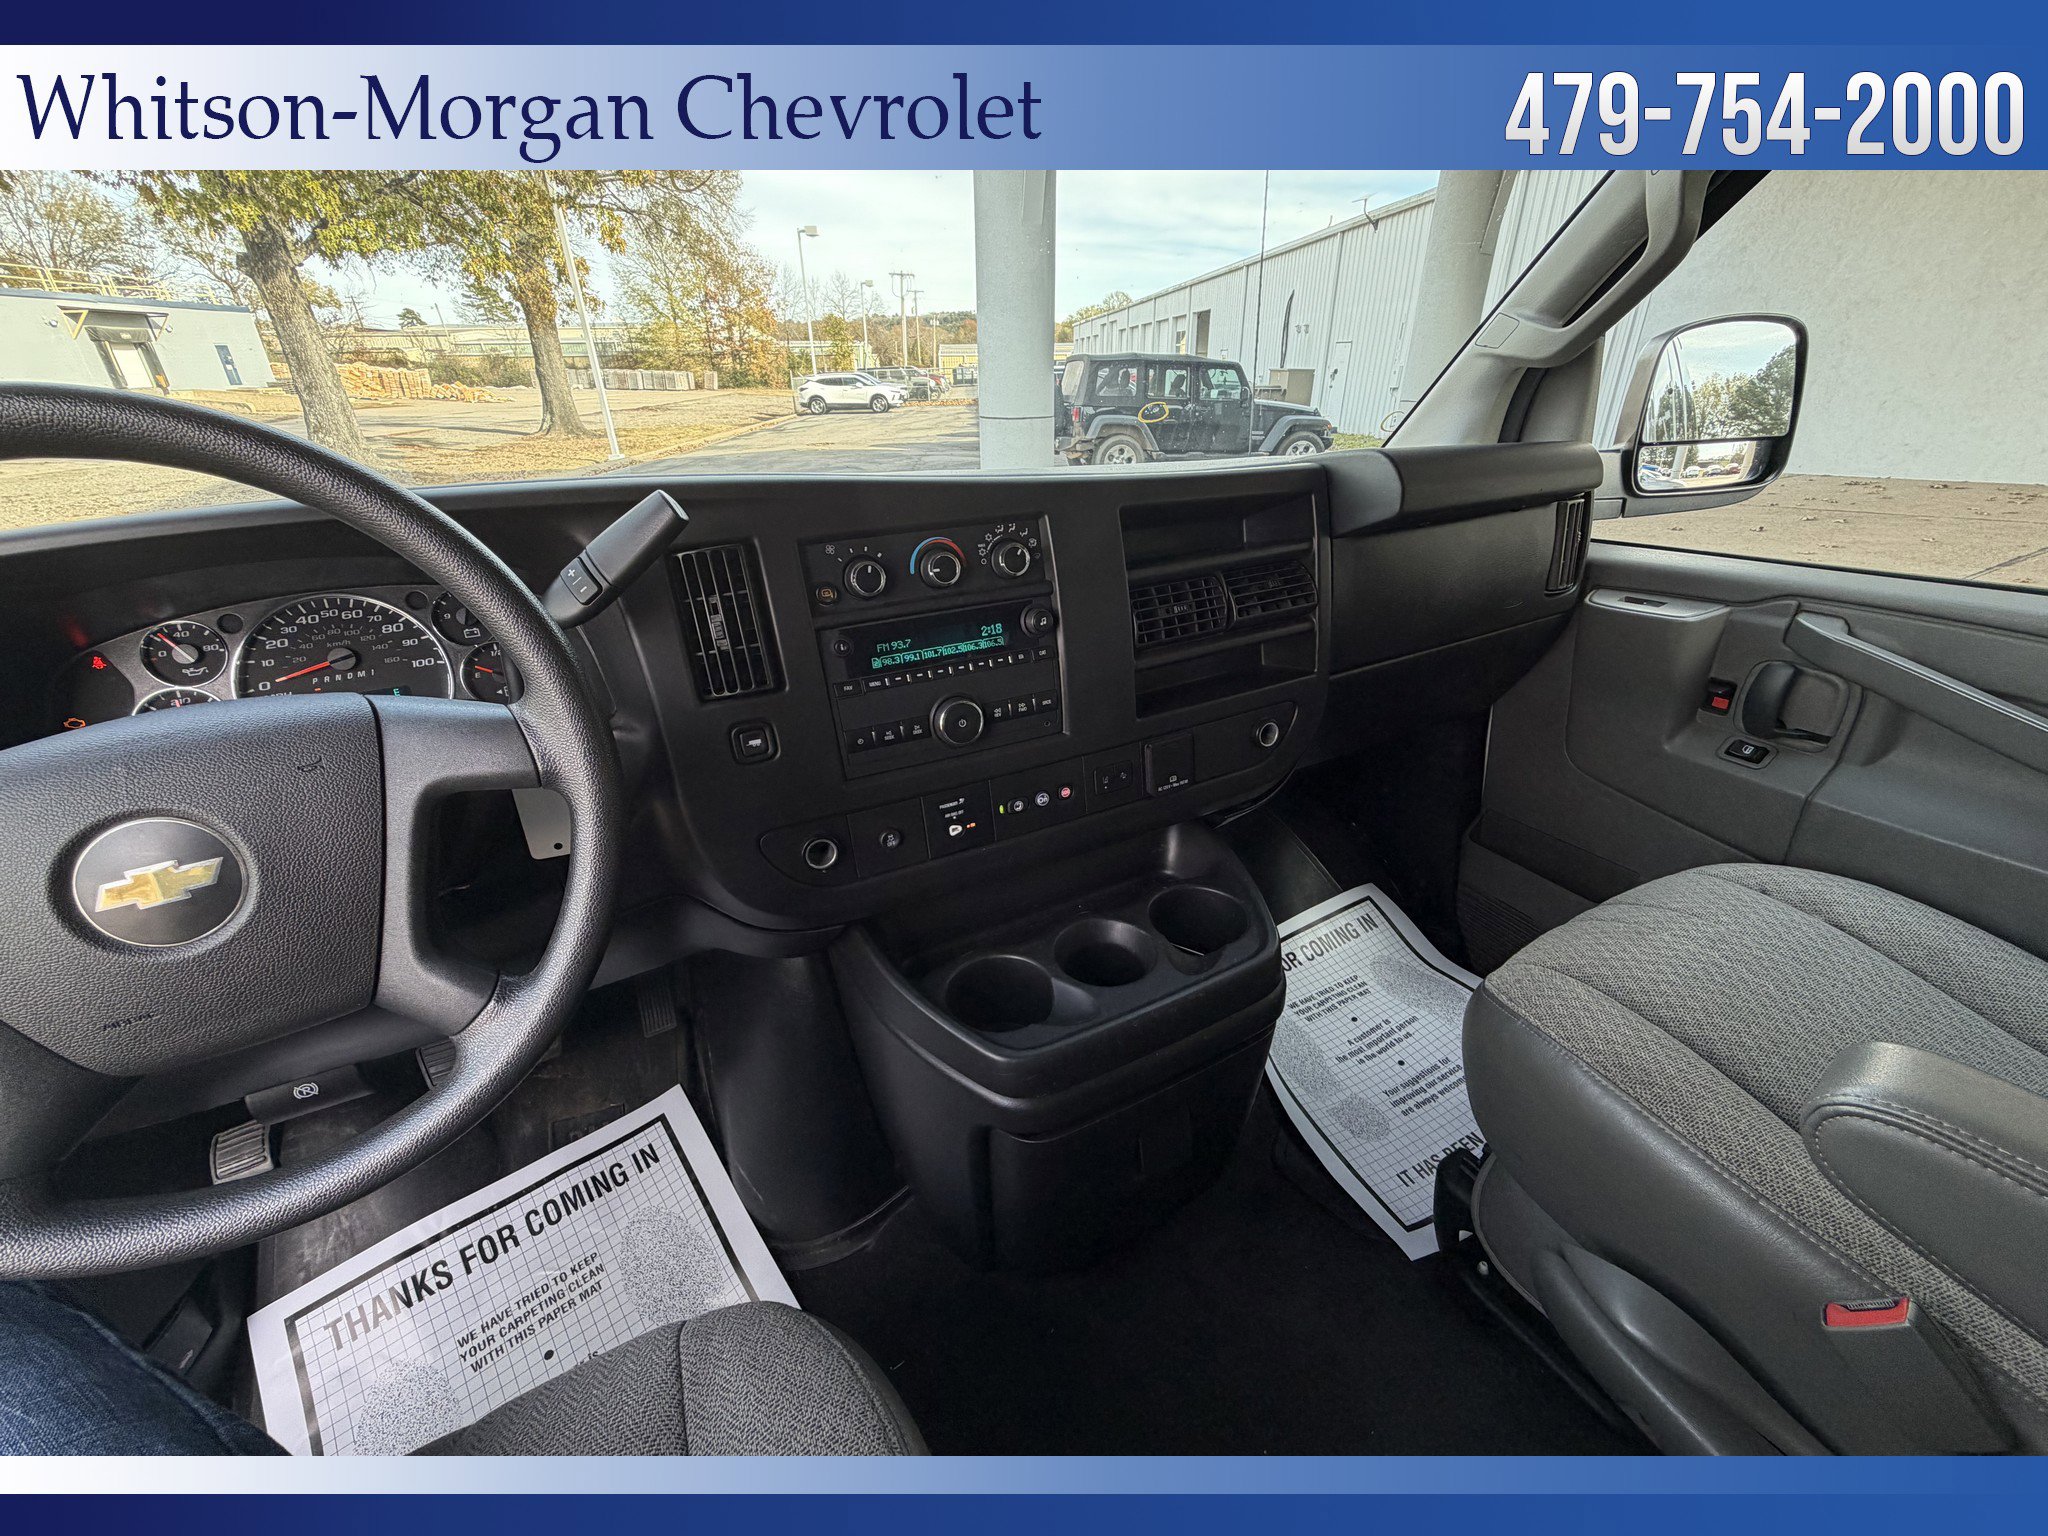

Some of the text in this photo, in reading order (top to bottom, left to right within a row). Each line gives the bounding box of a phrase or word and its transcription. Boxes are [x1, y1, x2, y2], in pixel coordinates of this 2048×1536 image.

[295, 614, 320, 624] 40
[320, 608, 338, 618] 50
[341, 609, 363, 620] 60
[367, 614, 382, 622] 70
[280, 626, 298, 634] 30
[382, 622, 404, 634] 80
[980, 623, 1003, 636] 2:18
[265, 638, 288, 650] 20
[326, 639, 351, 648] km/h
[402, 638, 418, 647] 90
[876, 639, 911, 653] FM 93.7
[261, 659, 275, 667] 10
[411, 658, 434, 668] 100
[882, 656, 900, 666] 98.3
[904, 653, 920, 662] 99.1
[924, 649, 942, 659] 101.7
[258, 681, 271, 691] 0
[393, 688, 400, 696] E
[1282, 913, 1379, 972] OR COMING IN
[1288, 1001, 1300, 1010] WE
[1299, 994, 1317, 1005] HAVE
[1315, 986, 1335, 998] TRIED
[1343, 974, 1358, 985] KEEP
[1294, 981, 1368, 1016] YOUR CARPETING CLEAN
[1304, 988, 1372, 1022] WITH THIS PAPER MAT
[1335, 1015, 1419, 1063] the most important person
[1354, 1022, 1384, 1044] customer
[1364, 1052, 1377, 1062] the
[1376, 1040, 1396, 1056] world
[1382, 1057, 1451, 1098] Your suggestions for
[1425, 1080, 1438, 1090] our
[1437, 1064, 1462, 1082] service
[1401, 1106, 1415, 1117] are
[1414, 1093, 1439, 1110] always
[1396, 1170, 1416, 1188] IT
[1412, 1154, 1440, 1179] HAS
[324, 1143, 661, 1352] THANKS FOR COMING IN
[457, 1252, 598, 1348] WE HAVE TRIED TO KEEP
[459, 1263, 605, 1363] YOUR CARPETING CLEAN
[470, 1280, 603, 1373] WITH THIS PAPER MAT
